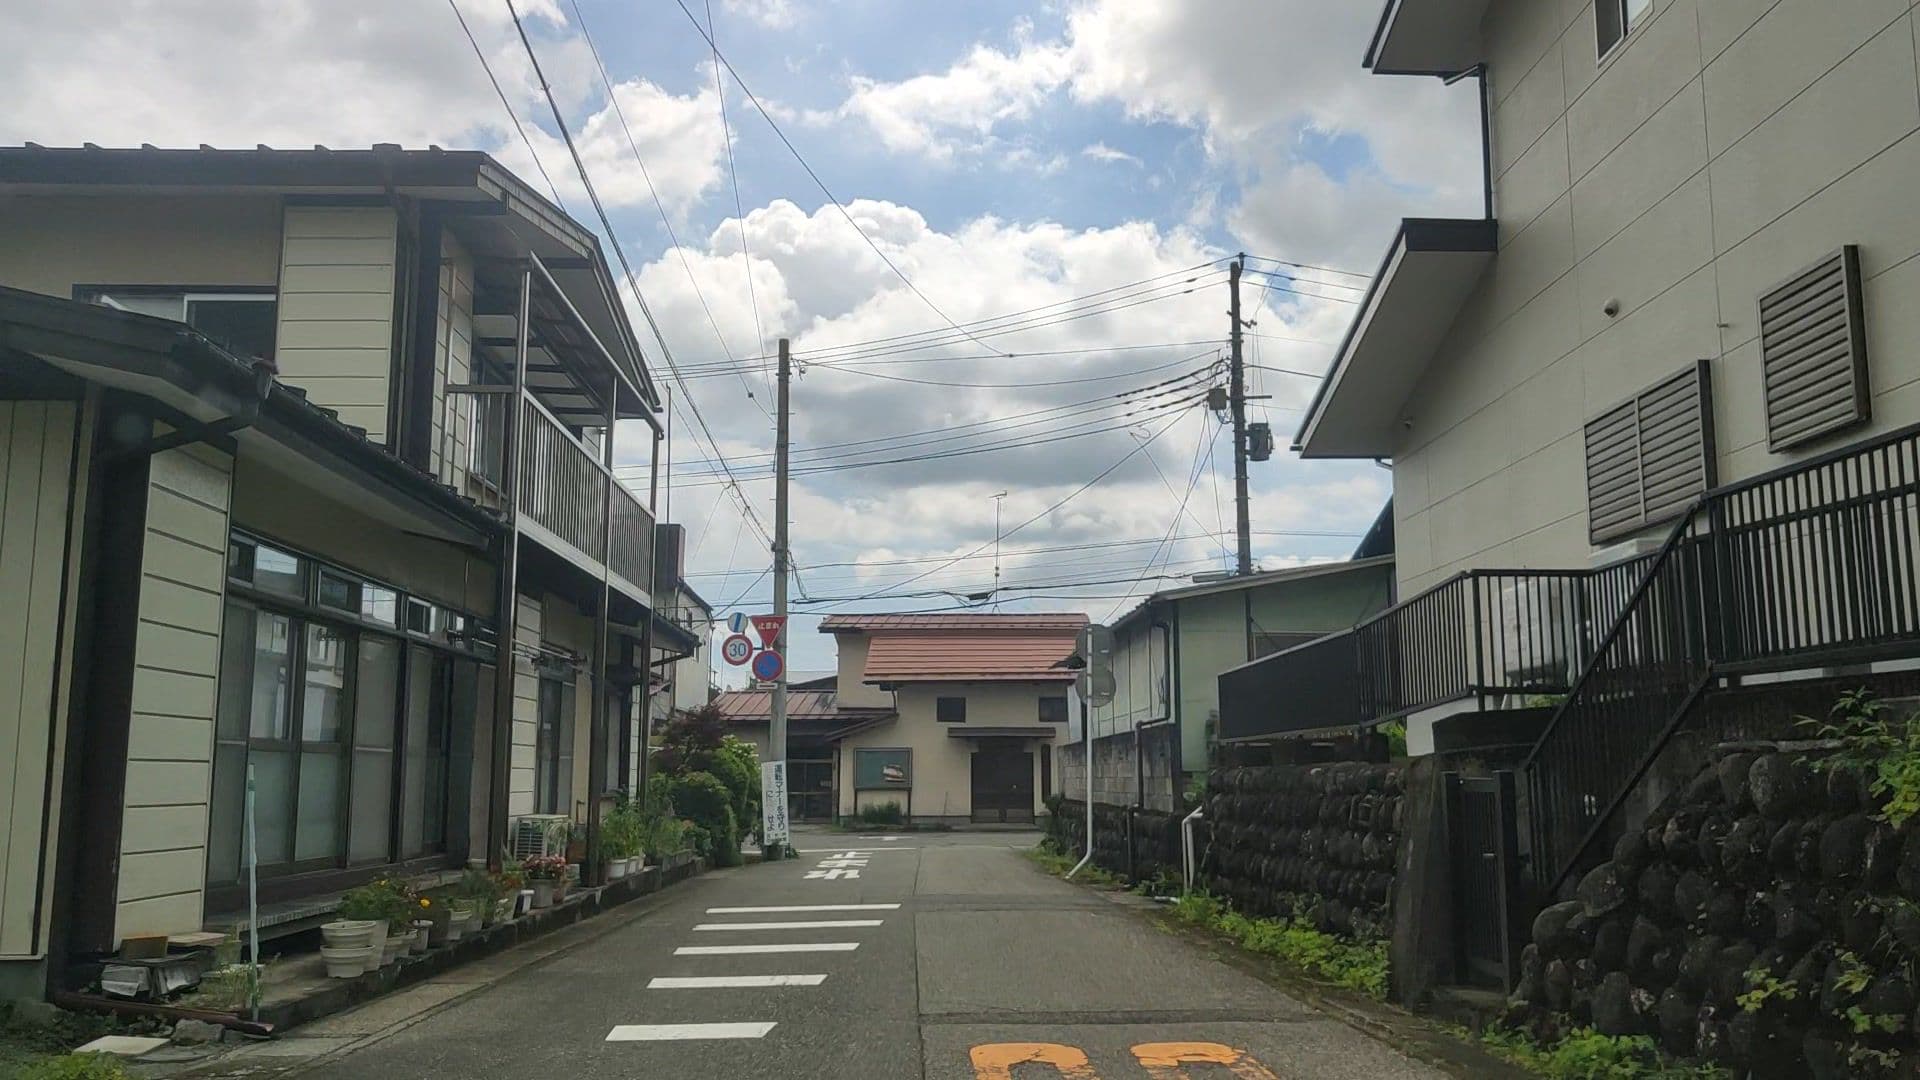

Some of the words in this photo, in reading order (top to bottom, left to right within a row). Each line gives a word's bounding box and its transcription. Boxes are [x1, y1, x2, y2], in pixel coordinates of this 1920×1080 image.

[758, 621, 780, 630] 止まれ
[729, 643, 746, 657] 30
